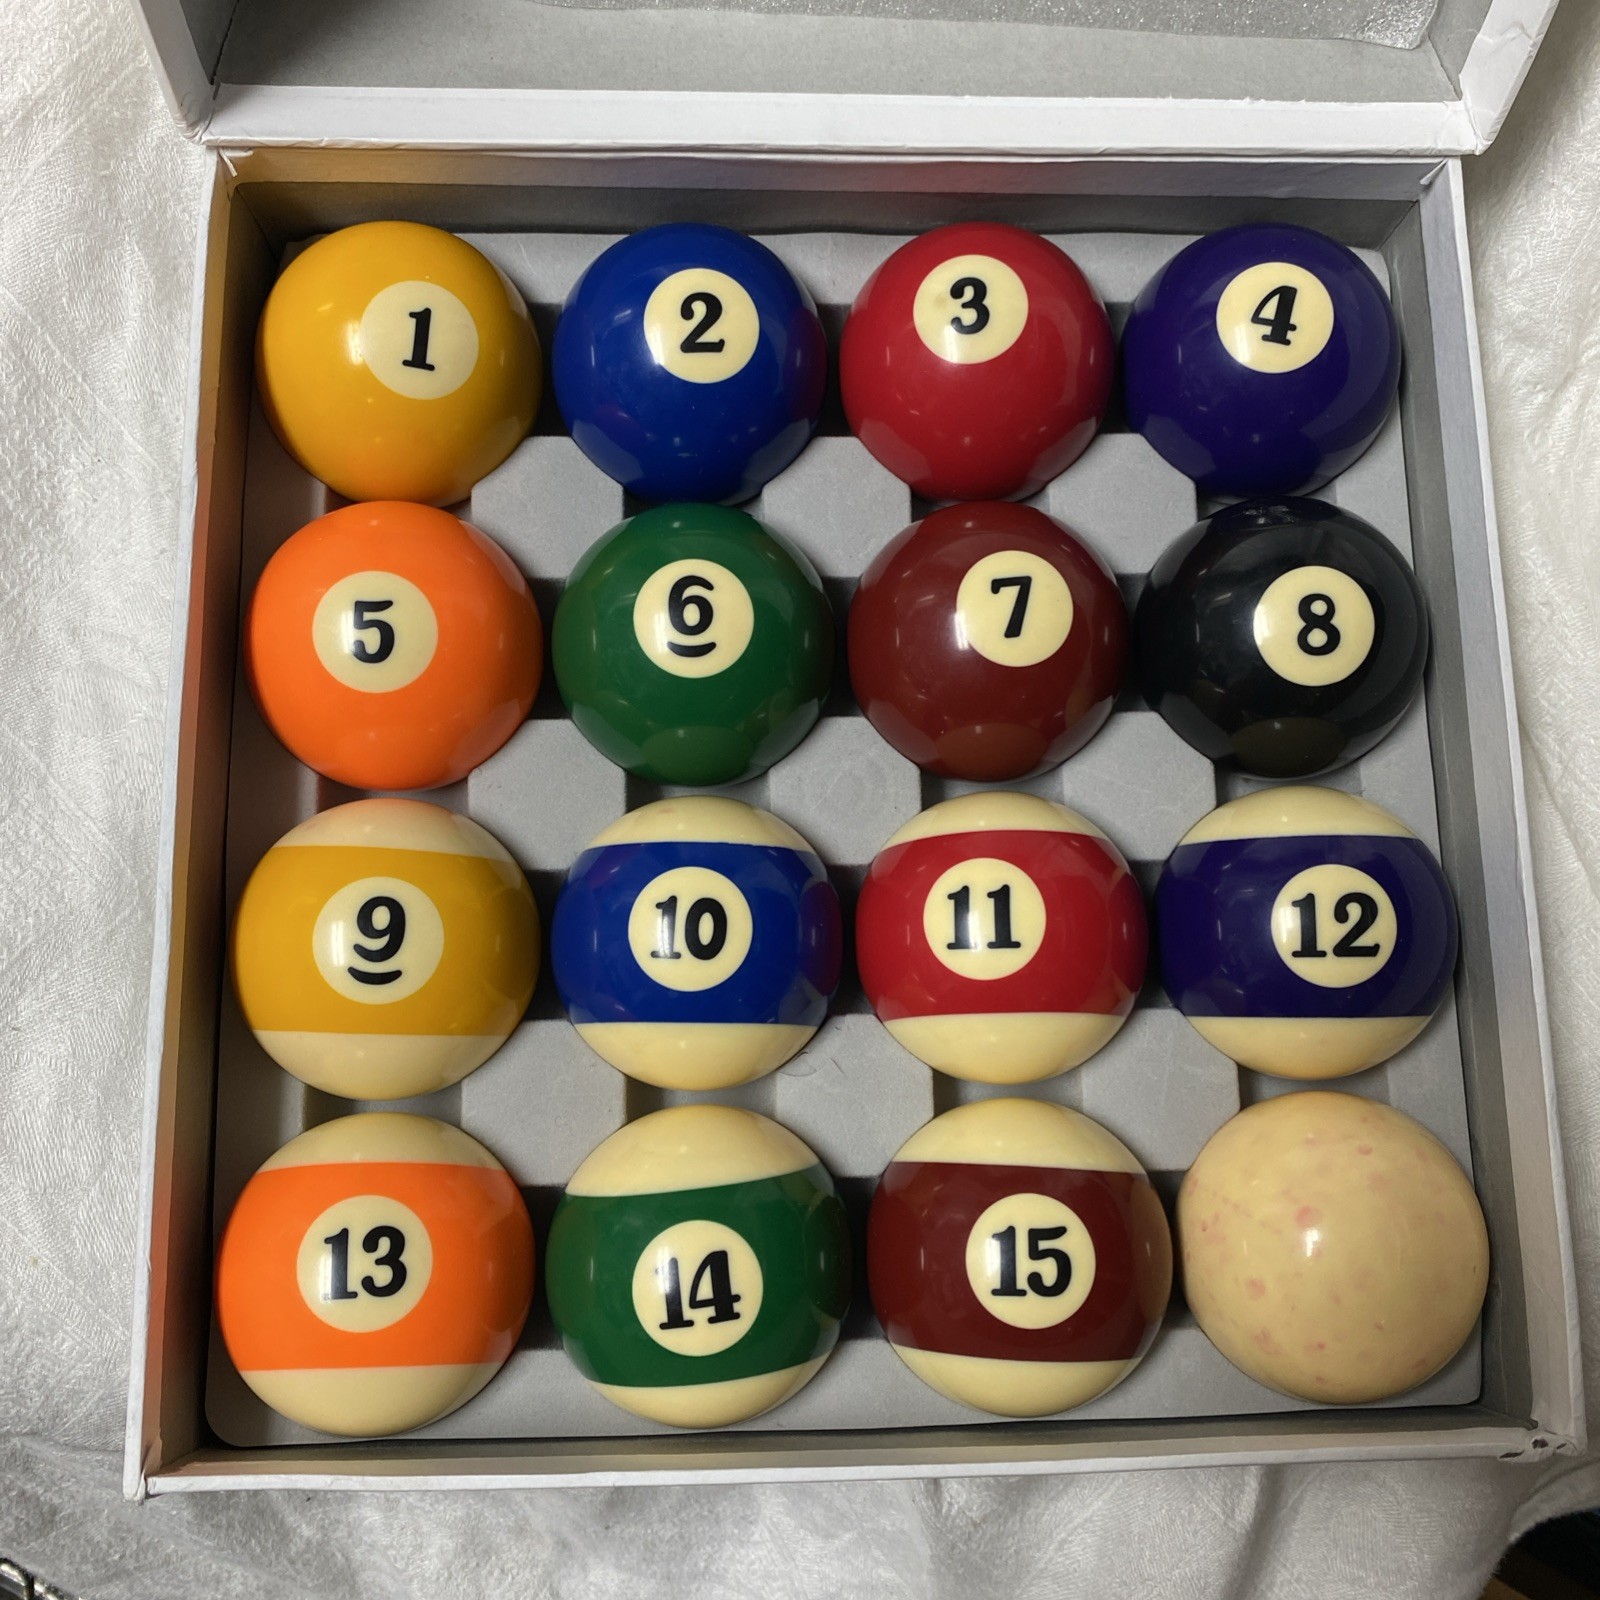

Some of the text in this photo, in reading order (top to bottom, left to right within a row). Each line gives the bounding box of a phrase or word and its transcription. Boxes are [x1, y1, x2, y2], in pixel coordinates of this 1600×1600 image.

[679, 292, 726, 354] 2
[949, 277, 991, 335] 3
[1251, 285, 1298, 346] 4
[401, 307, 436, 372] 1
[352, 599, 396, 664] 5
[668, 575, 715, 637] 6
[990, 575, 1033, 639] 7
[1296, 592, 1342, 657] 8
[352, 895, 407, 963] 9
[650, 895, 728, 961] 10
[945, 884, 1022, 951] 11
[1291, 891, 1381, 959] 12
[323, 1224, 408, 1301] 13
[658, 1249, 742, 1330] 14
[990, 1225, 1073, 1298] 15
